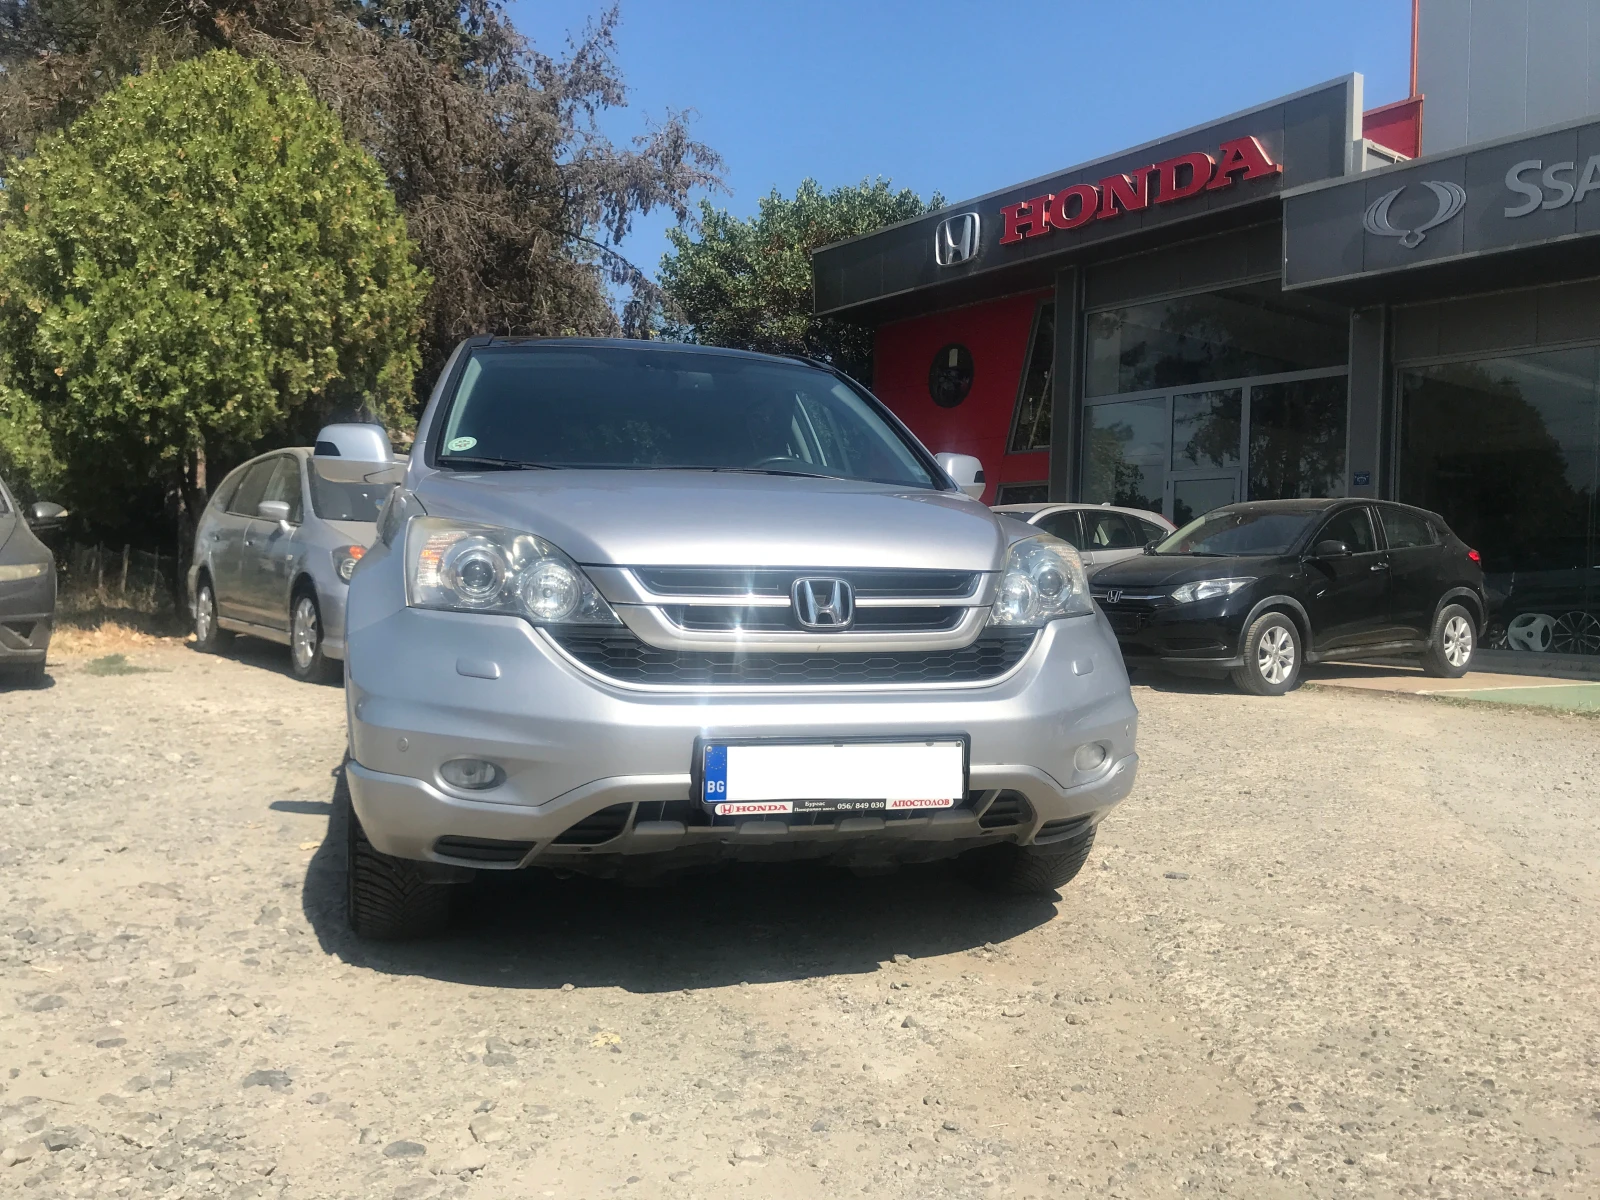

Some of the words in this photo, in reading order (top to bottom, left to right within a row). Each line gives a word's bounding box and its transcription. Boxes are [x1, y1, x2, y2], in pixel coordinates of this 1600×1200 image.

[1000, 136, 1283, 244] HONDA
[707, 780, 725, 793] BG
[736, 804, 788, 812] HONDA
[891, 799, 950, 807] АПОСТОЛОВ
